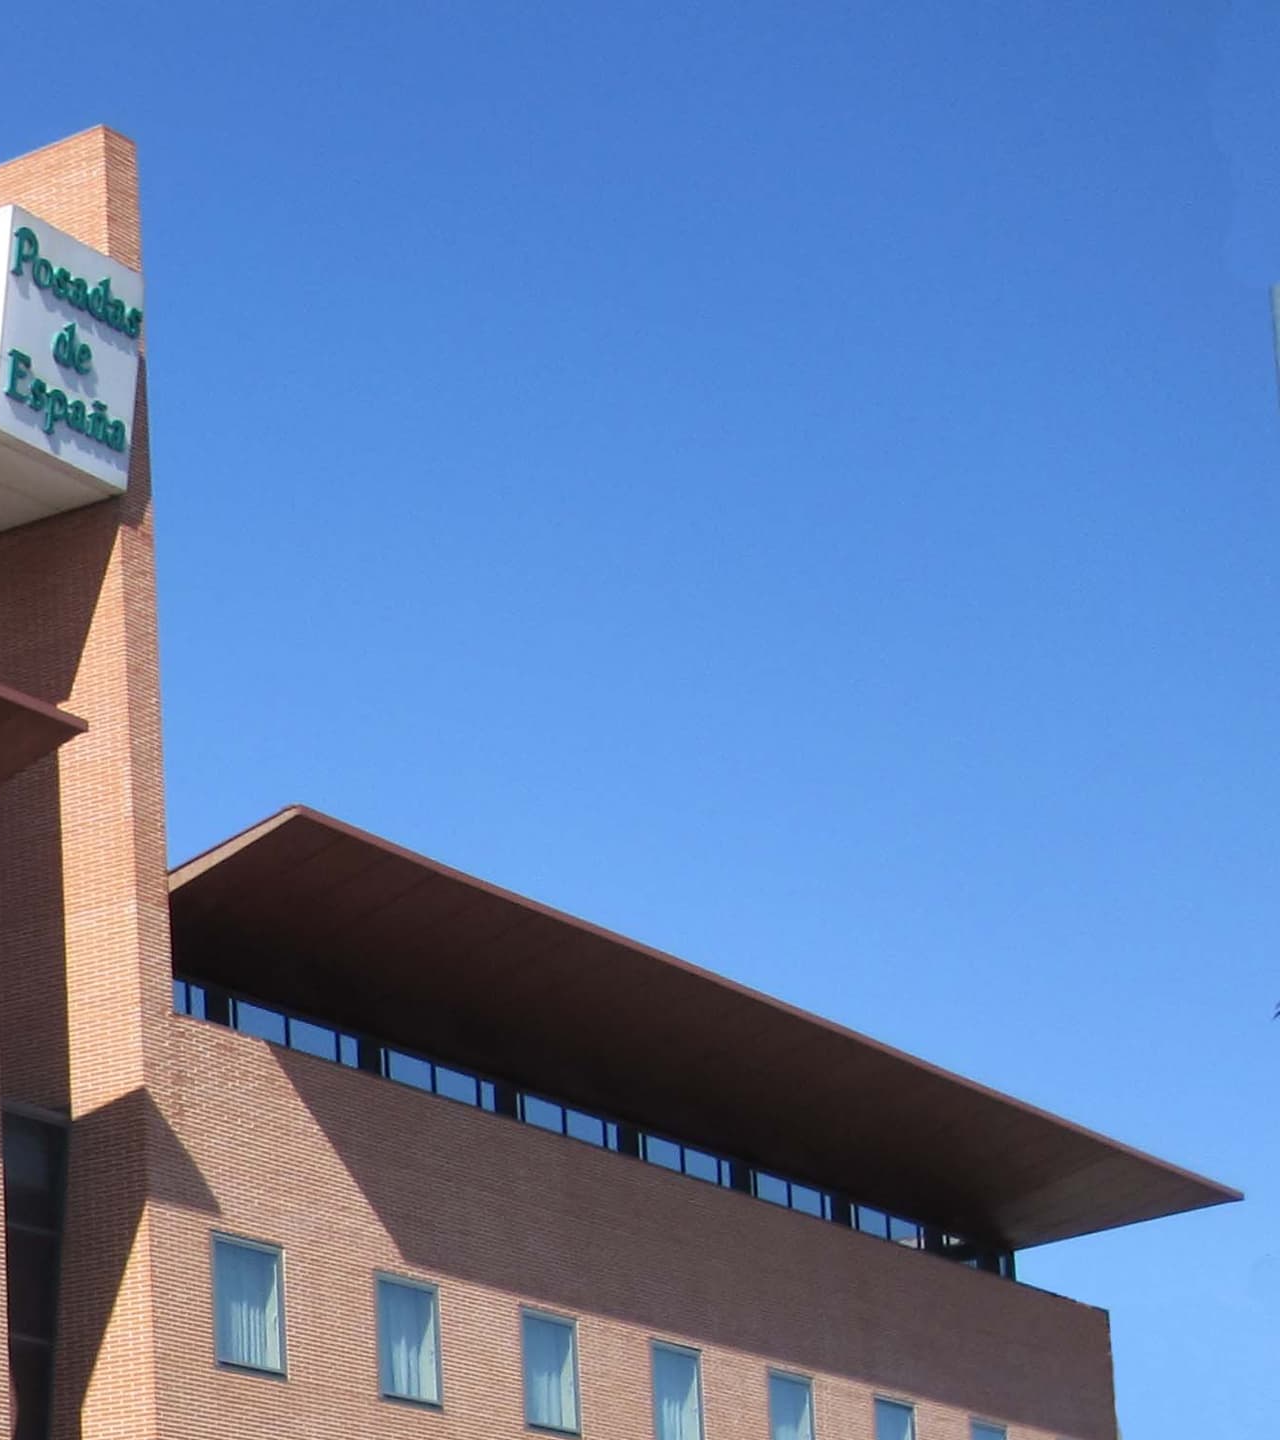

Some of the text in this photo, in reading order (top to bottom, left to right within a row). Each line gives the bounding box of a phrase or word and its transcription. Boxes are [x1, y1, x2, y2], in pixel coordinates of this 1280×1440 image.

[10, 226, 143, 338] Posadas
[4, 348, 126, 453] España
[52, 322, 93, 375] de
